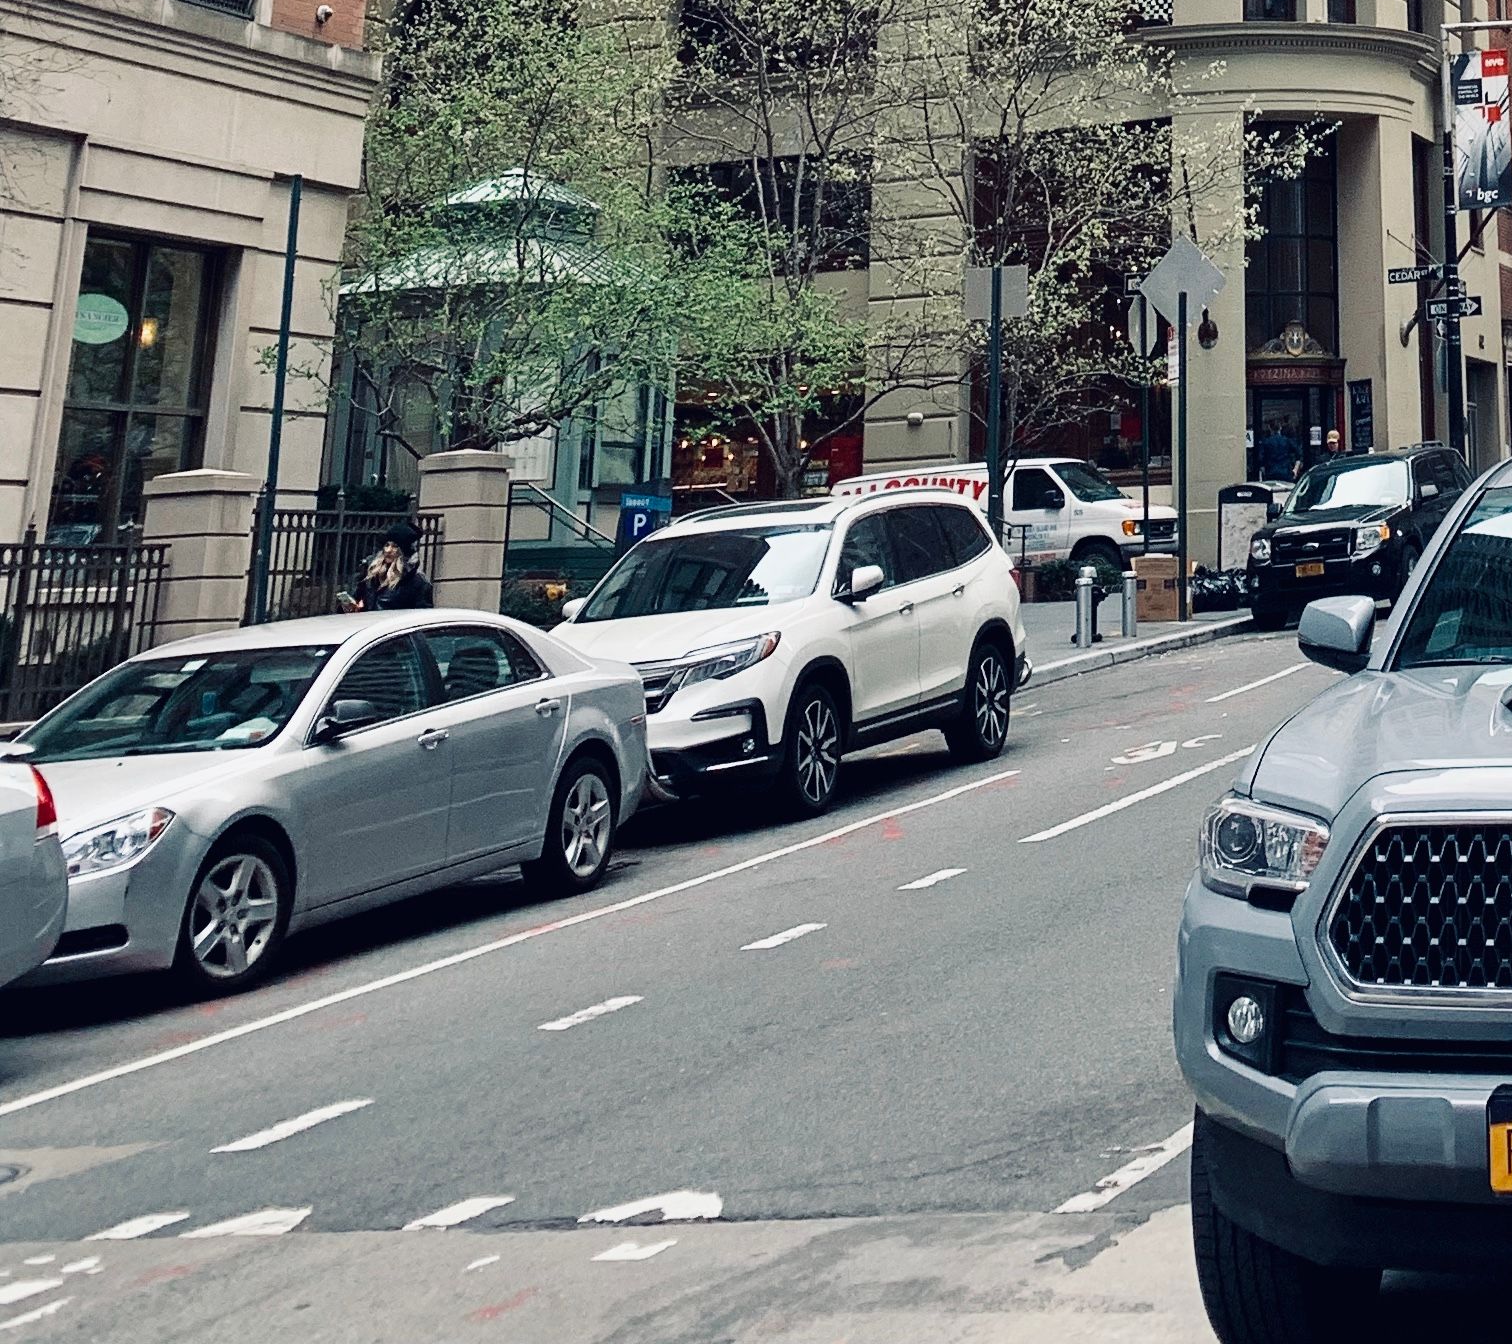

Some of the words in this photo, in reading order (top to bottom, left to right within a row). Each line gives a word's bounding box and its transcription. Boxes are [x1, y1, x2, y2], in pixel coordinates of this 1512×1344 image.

[1477, 188, 1499, 203] bgc
[1389, 271, 1421, 282] CEDAR
[1434, 305, 1447, 313] ON
[633, 513, 647, 536] P
